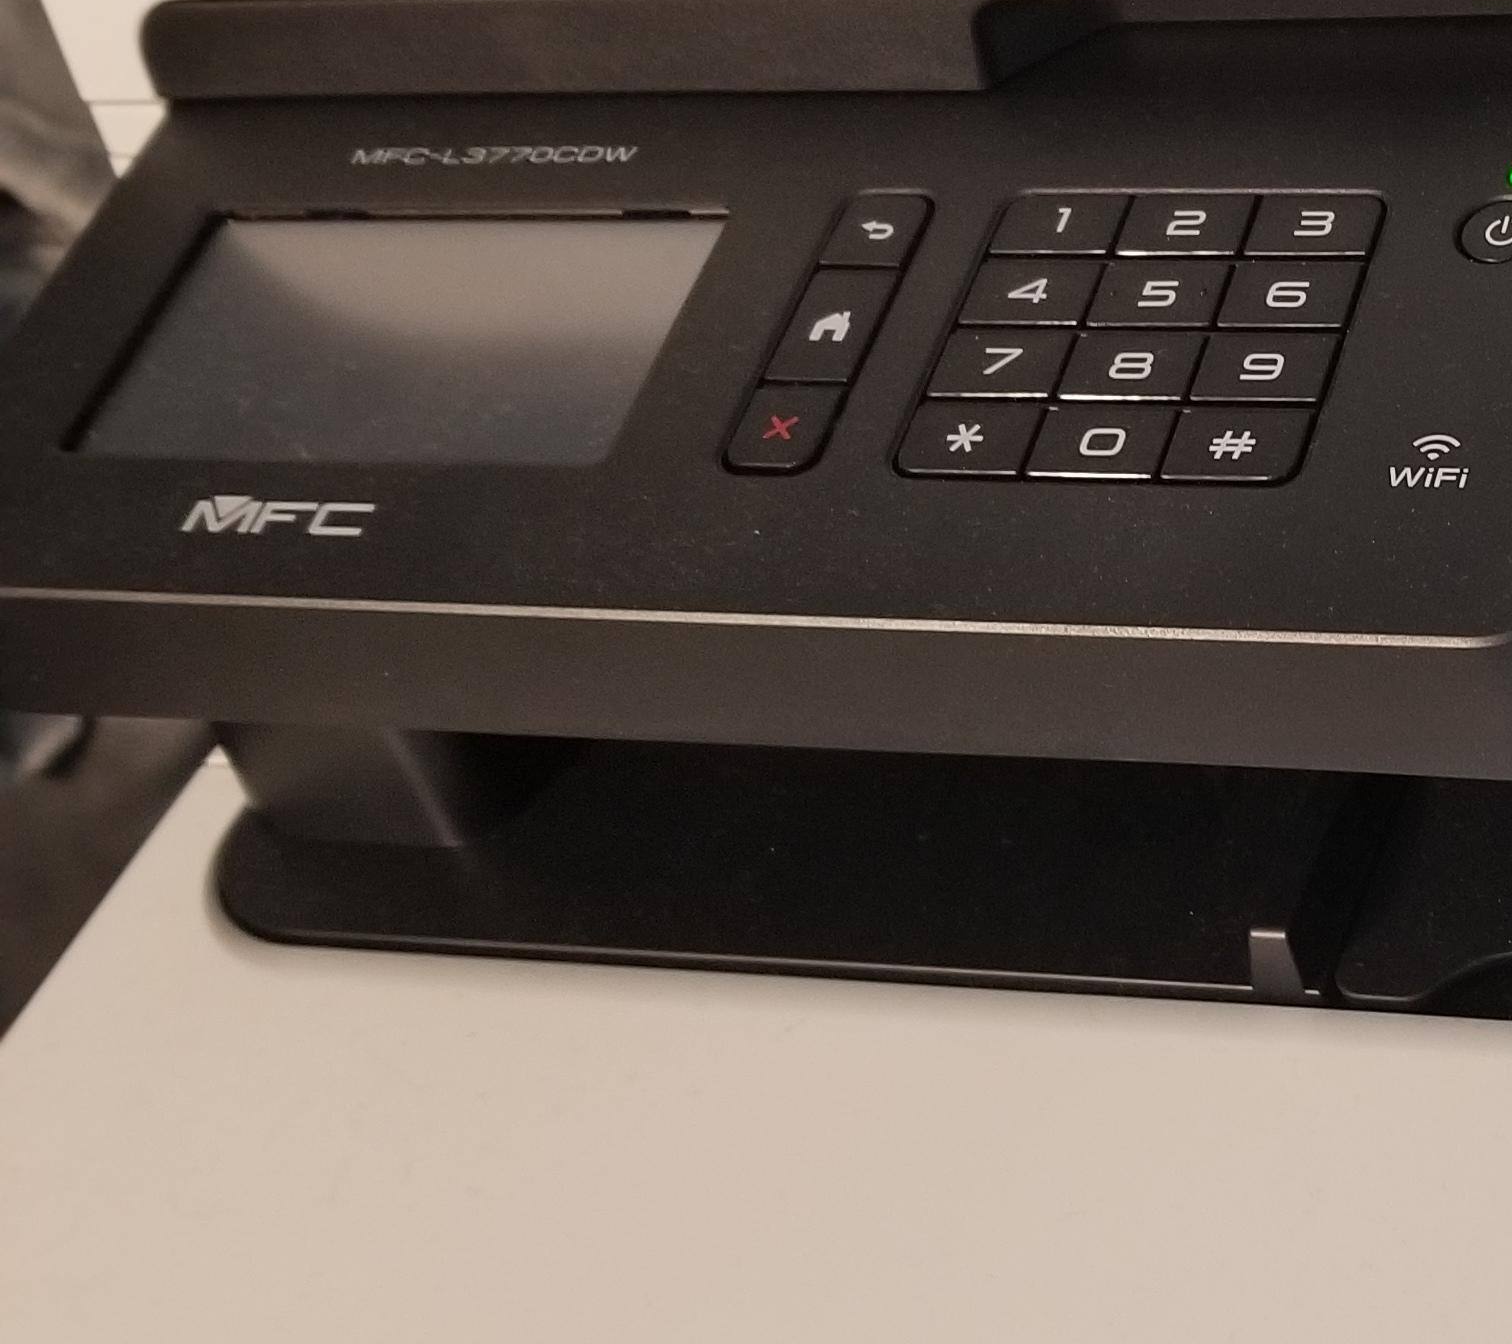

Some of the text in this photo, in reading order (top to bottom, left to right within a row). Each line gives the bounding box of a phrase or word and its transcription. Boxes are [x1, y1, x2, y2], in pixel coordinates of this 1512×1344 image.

[352, 146, 637, 165] MFC-L3770CDW
[1057, 207, 1336, 237] 1 2 3
[1008, 277, 1310, 308] 4 5 6
[983, 347, 1285, 381] 7 8 9
[1079, 427, 1127, 456] 0
[1208, 430, 1257, 460] #
[1389, 466, 1469, 489] WiFi
[181, 495, 376, 536] MFC
